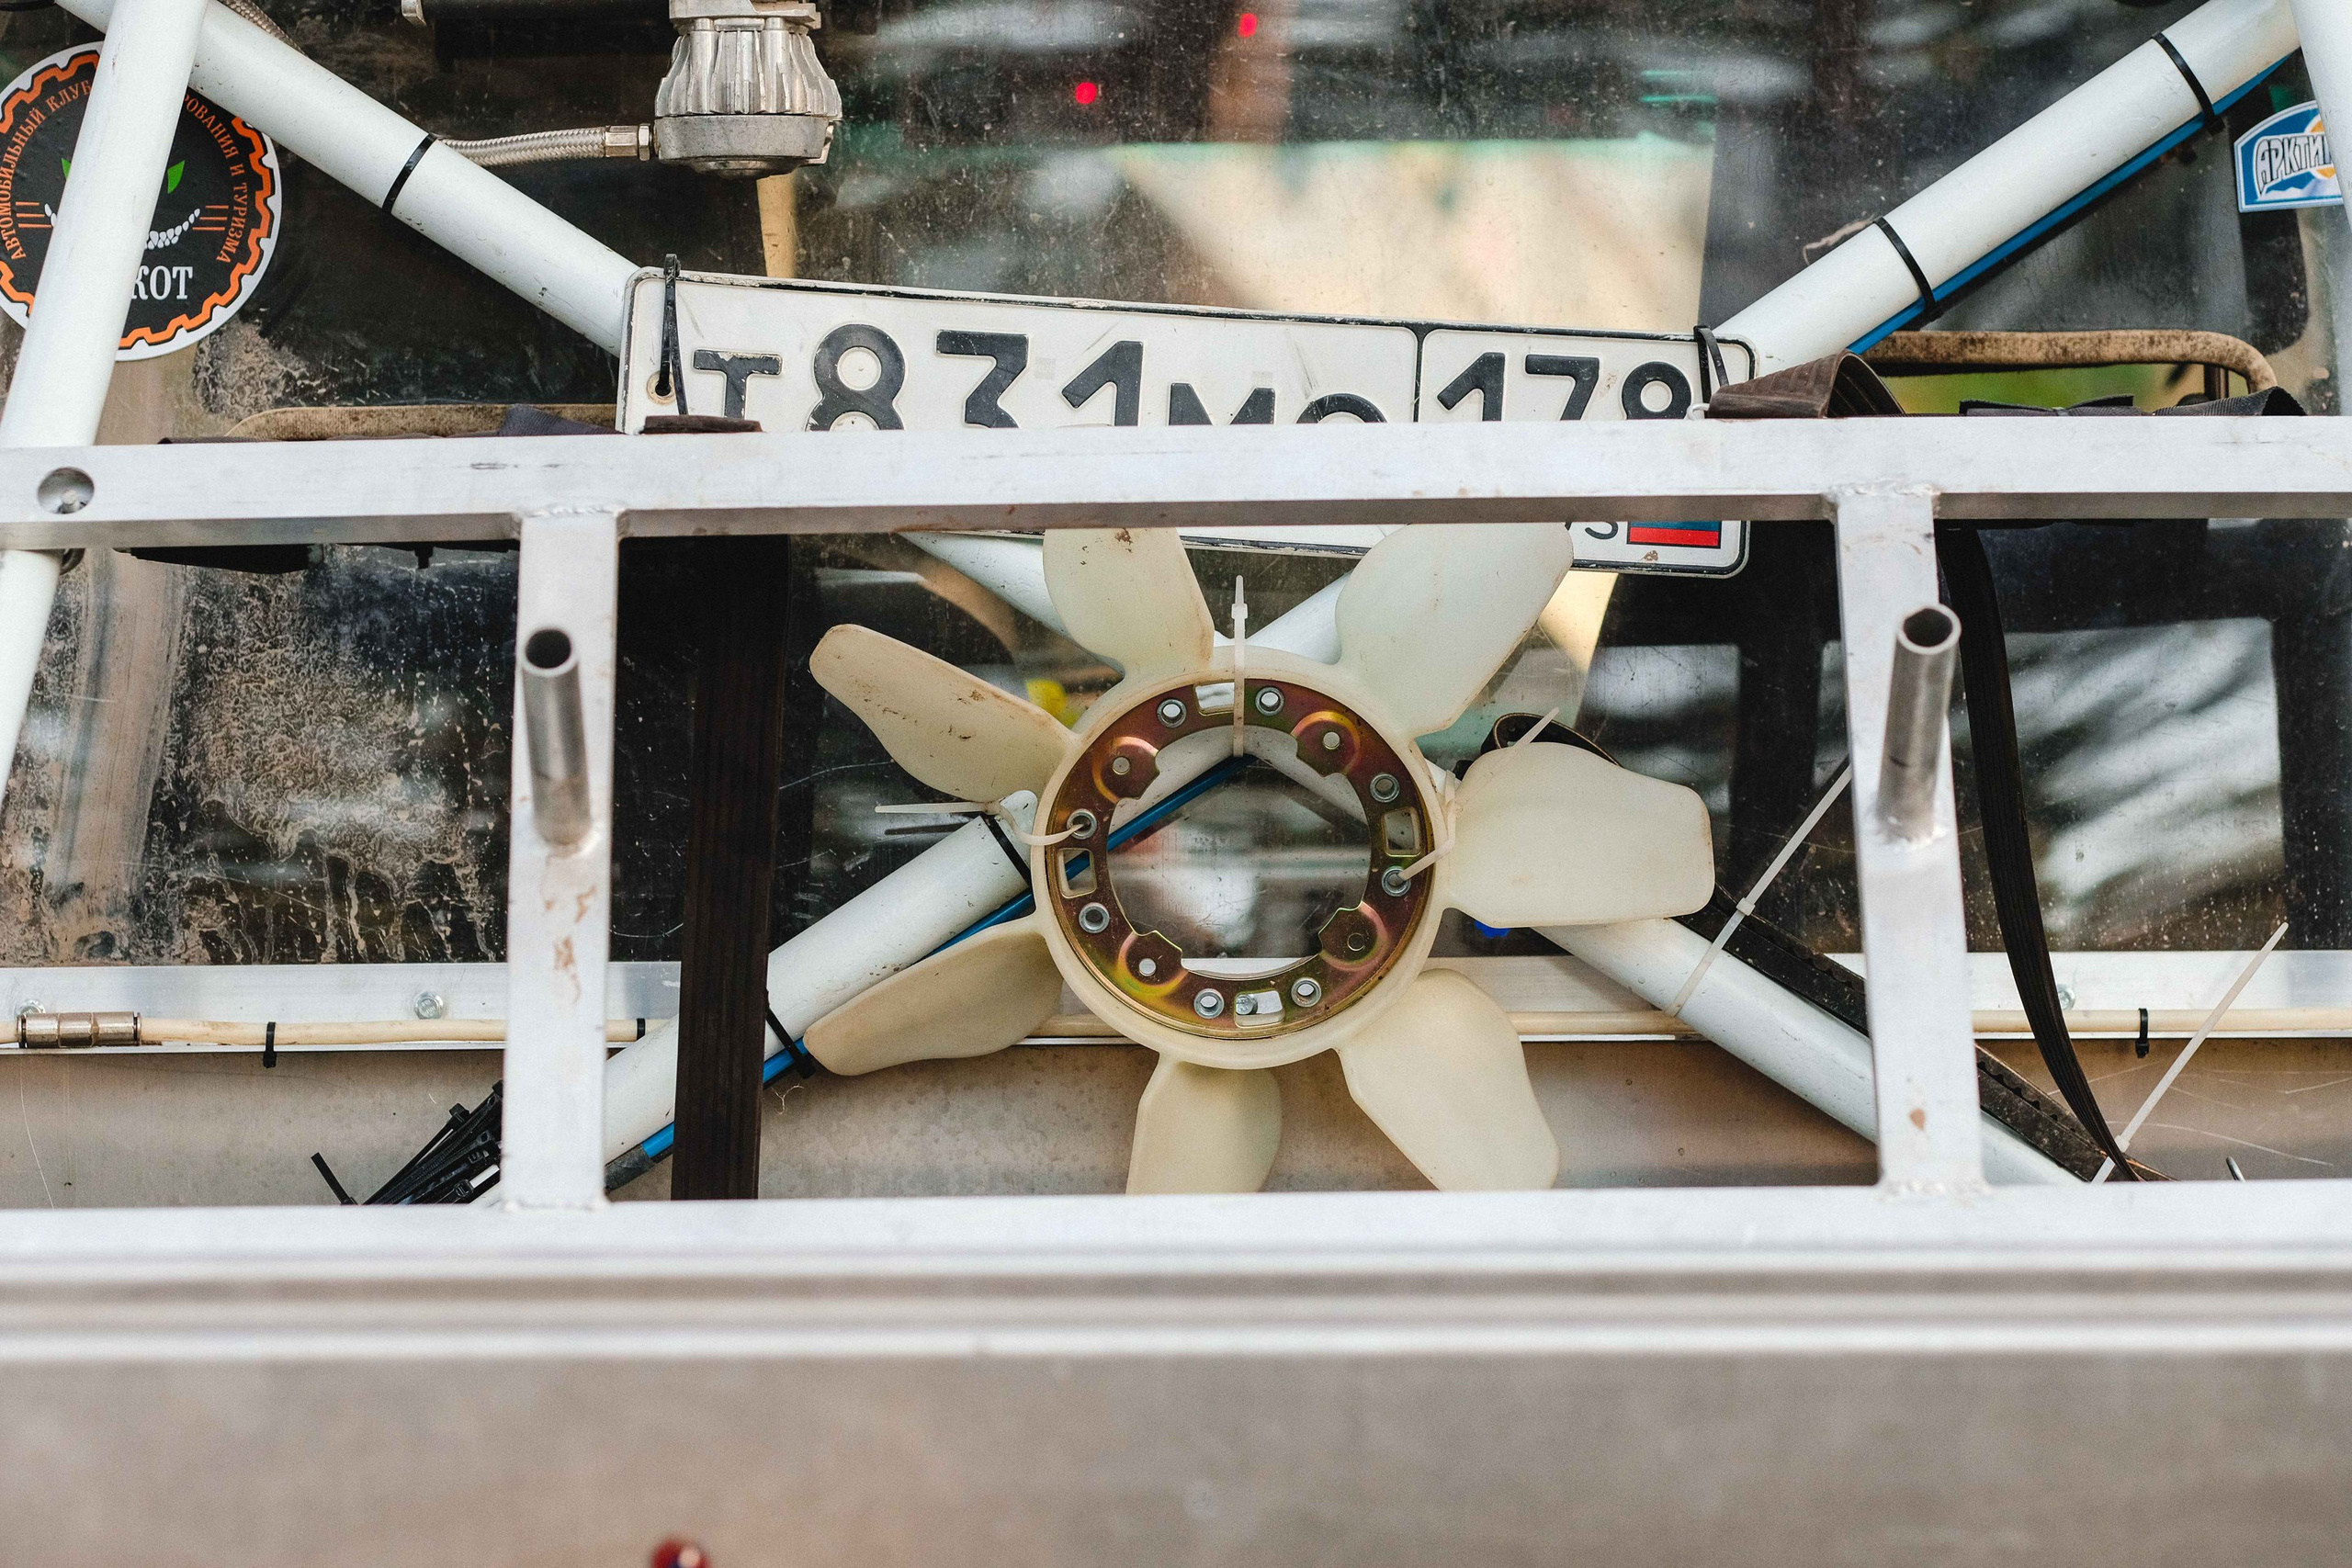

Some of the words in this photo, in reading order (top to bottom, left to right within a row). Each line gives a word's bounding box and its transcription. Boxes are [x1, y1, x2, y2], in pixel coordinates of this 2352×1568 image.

[46, 79, 92, 112] КЛУБ
[184, 93, 240, 160] ОВАНИЯ
[0, 107, 46, 260] АВТОМОБИЛЬНЫЙ
[230, 163, 245, 177] И
[216, 182, 248, 264] ТУРИЗМА
[693, 322, 1387, 432] Т831
